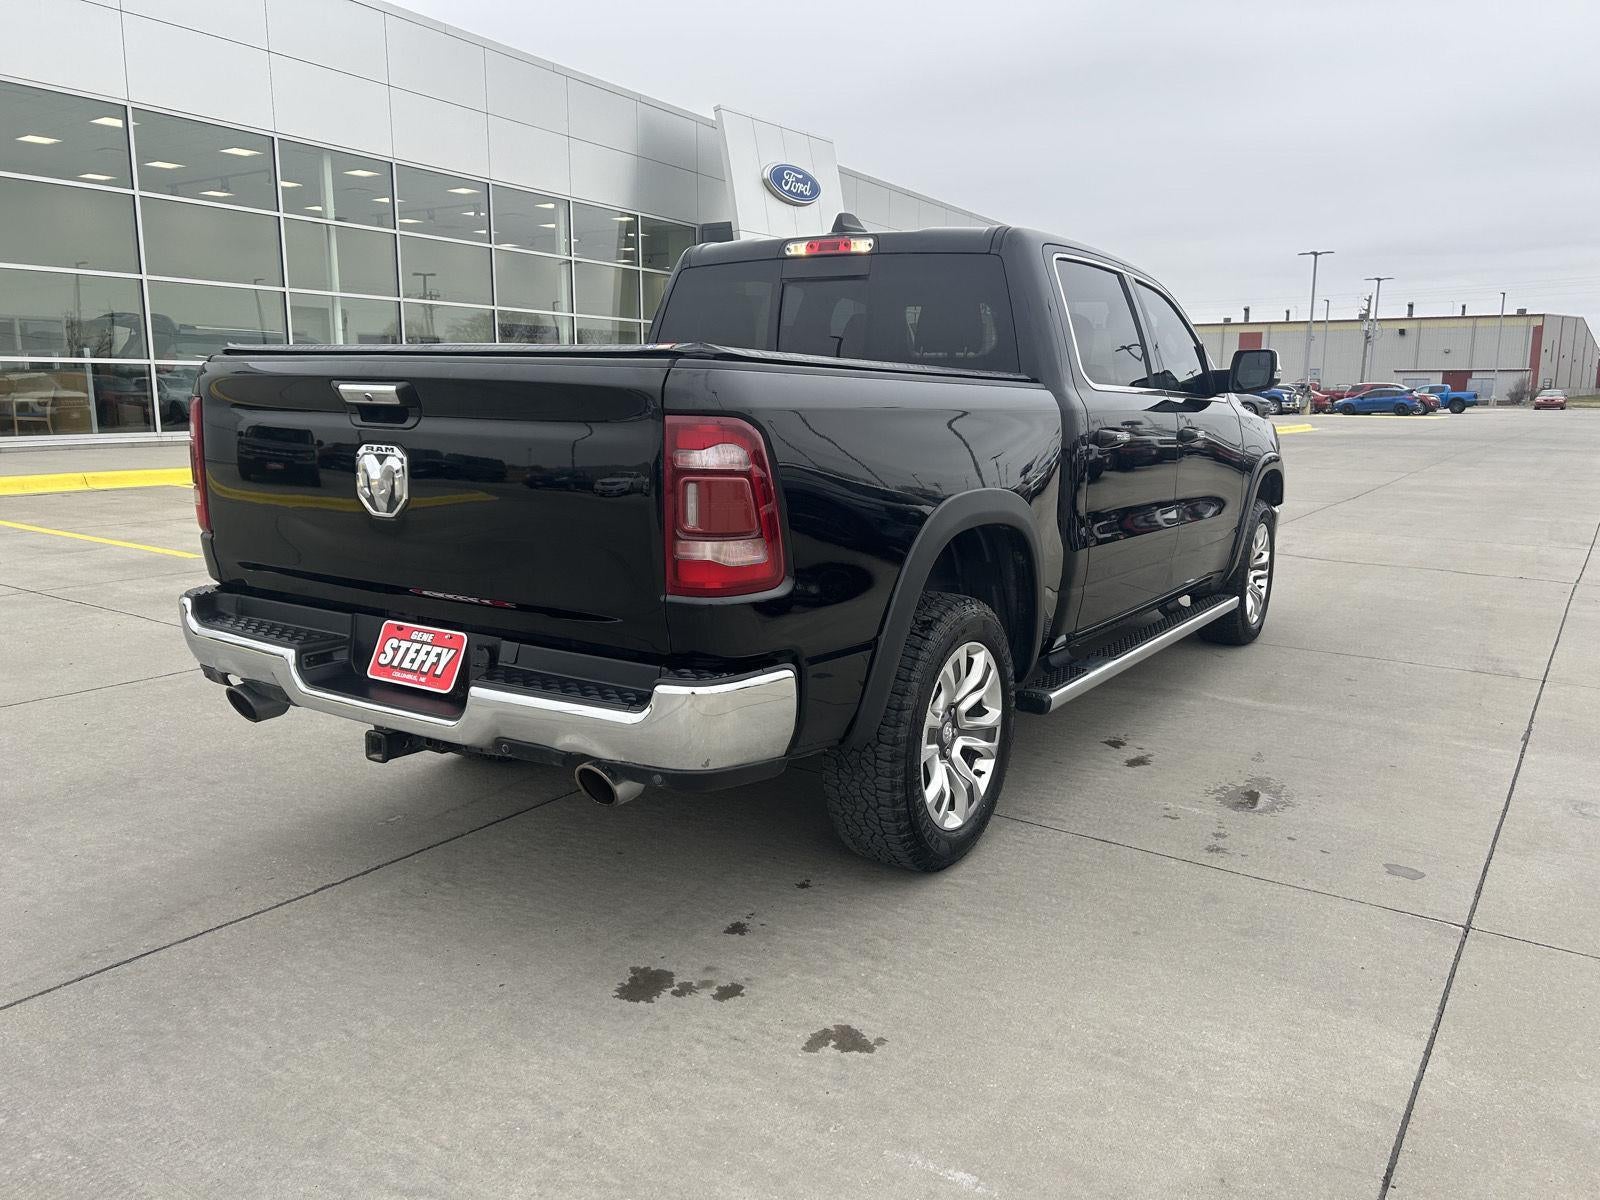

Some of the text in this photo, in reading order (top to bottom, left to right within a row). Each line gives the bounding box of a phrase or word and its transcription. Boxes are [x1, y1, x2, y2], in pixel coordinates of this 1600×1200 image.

[781, 170, 812, 196] Ford
[364, 445, 395, 454] RAM
[410, 630, 435, 643] GENE
[377, 637, 457, 677] STEFFY
